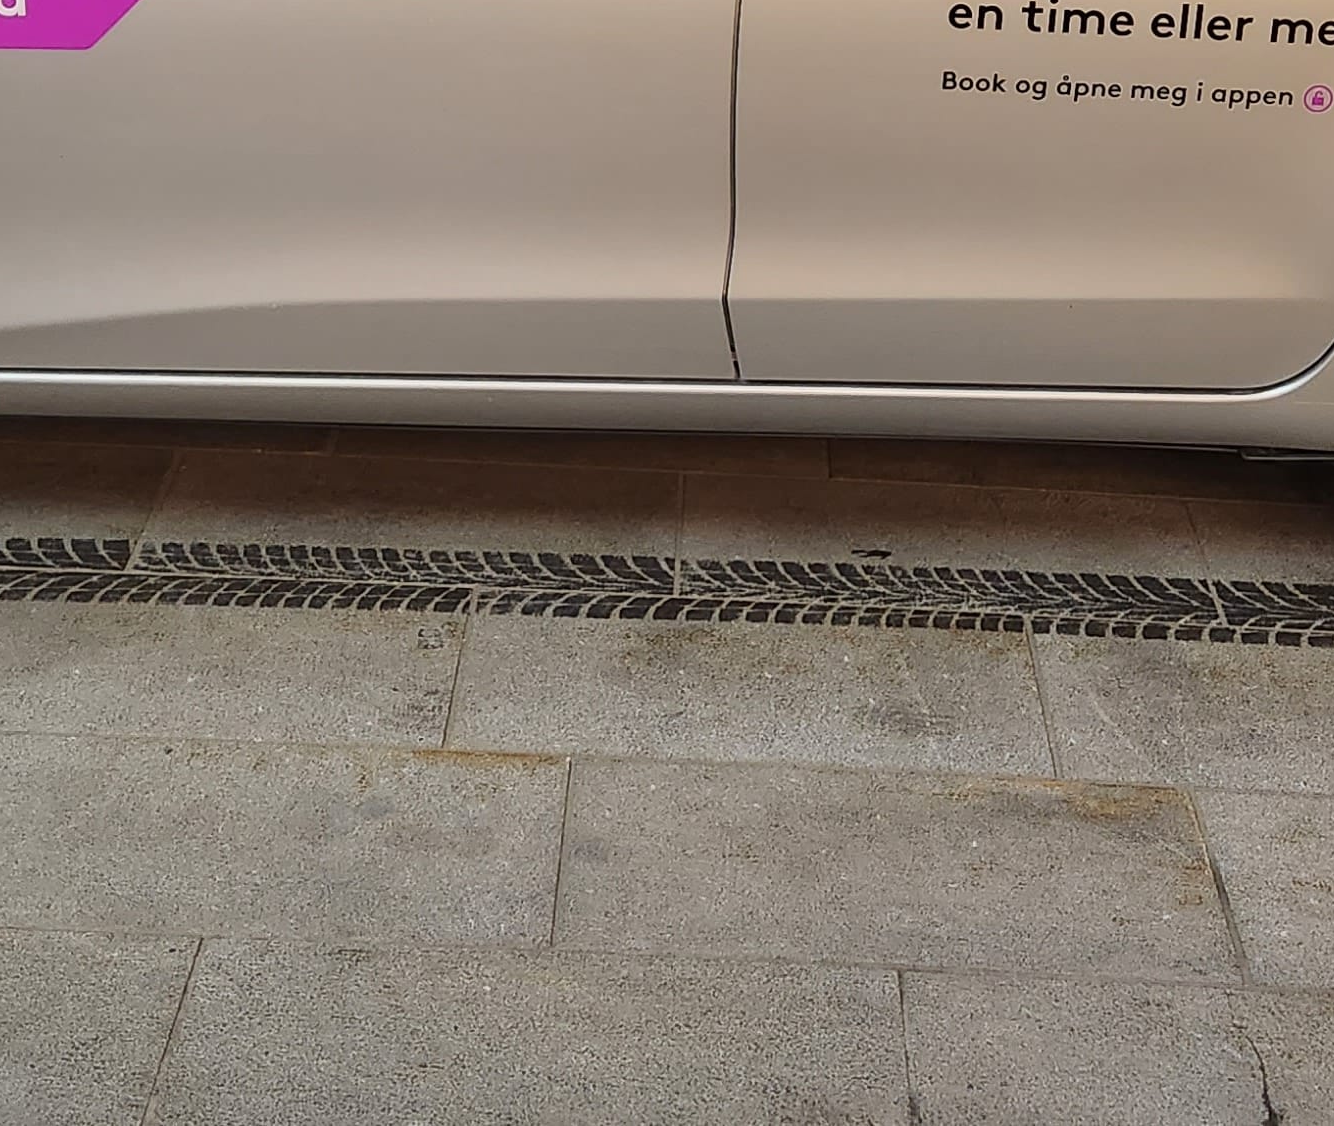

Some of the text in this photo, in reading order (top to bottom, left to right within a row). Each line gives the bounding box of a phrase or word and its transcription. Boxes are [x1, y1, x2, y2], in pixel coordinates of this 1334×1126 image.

[947, 2, 1004, 31] en
[1150, 3, 1254, 42] eller
[941, 71, 1294, 109] Book og åpne meg i appen
